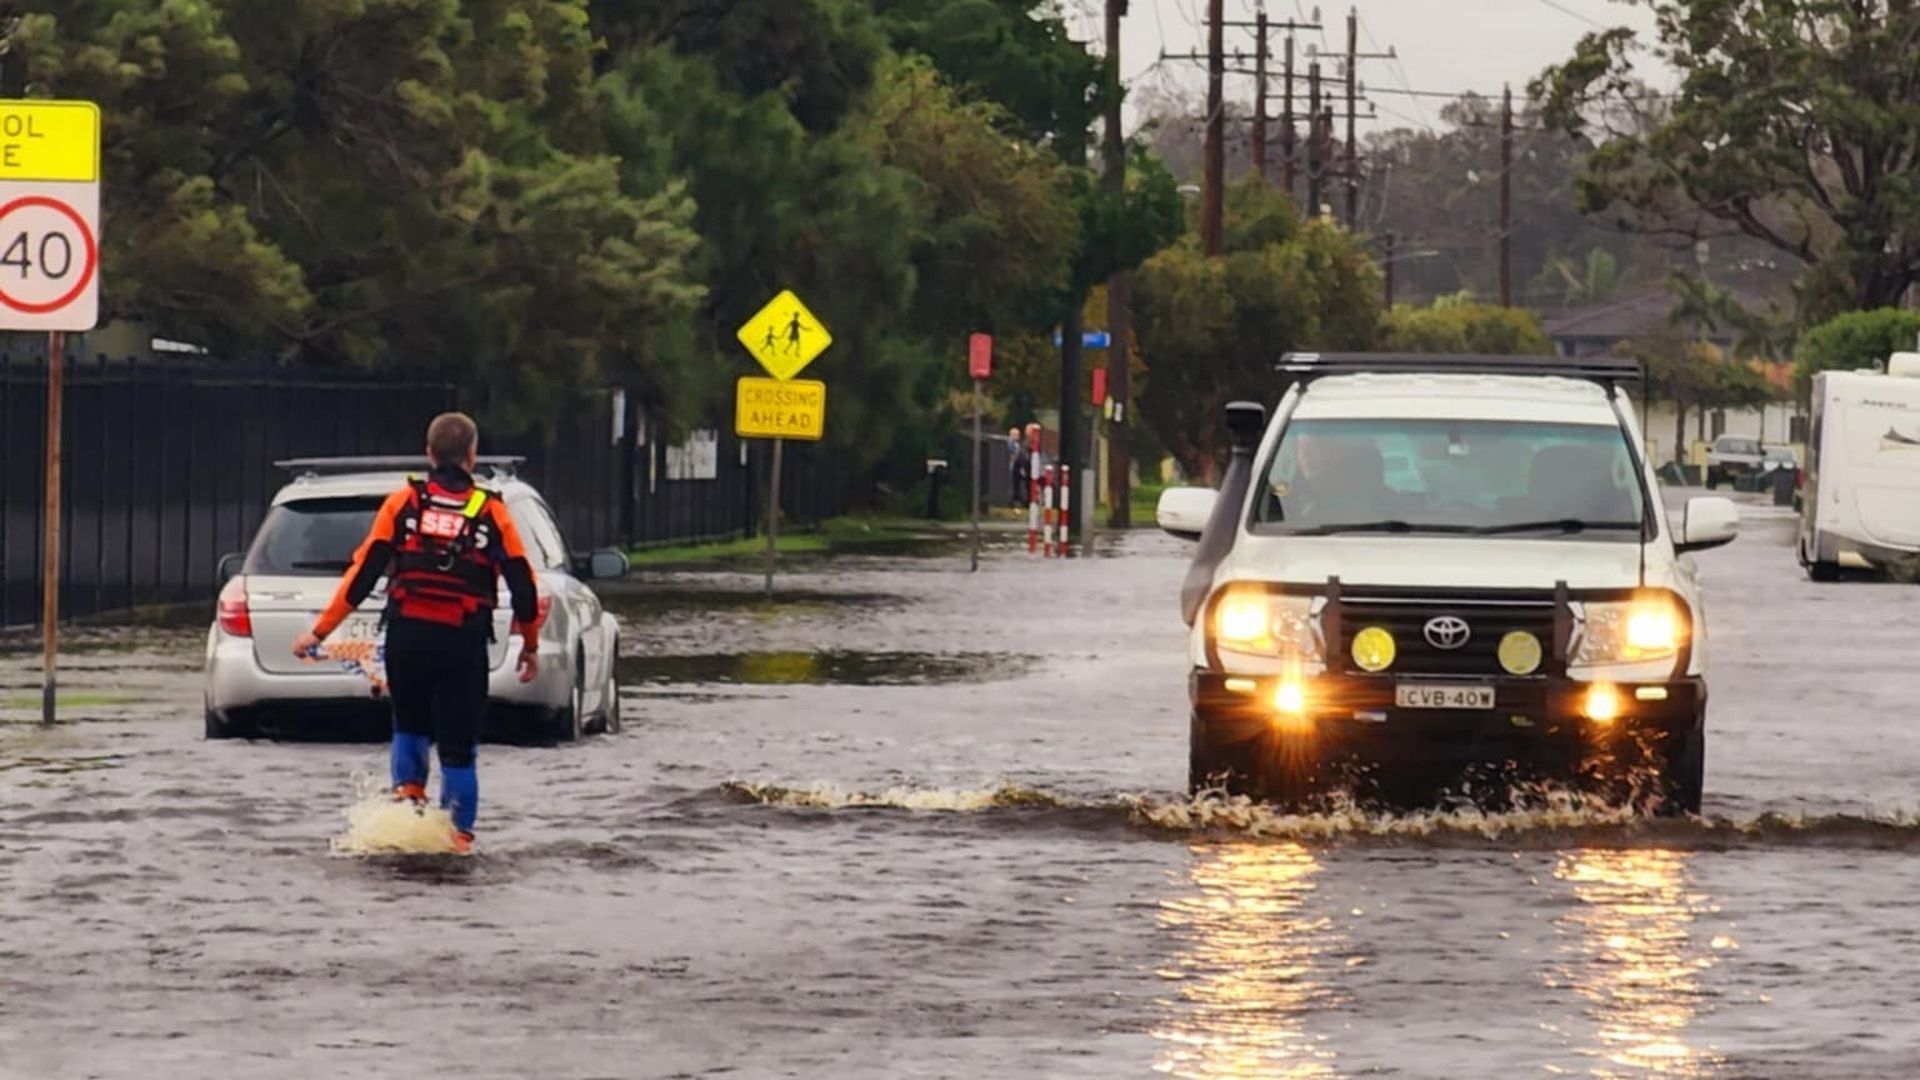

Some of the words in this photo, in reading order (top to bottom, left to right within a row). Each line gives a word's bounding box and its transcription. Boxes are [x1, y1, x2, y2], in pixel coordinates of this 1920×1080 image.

[0, 231, 71, 279] 40
[745, 388, 818, 408] CROSSING
[751, 411, 812, 428] AHEAD
